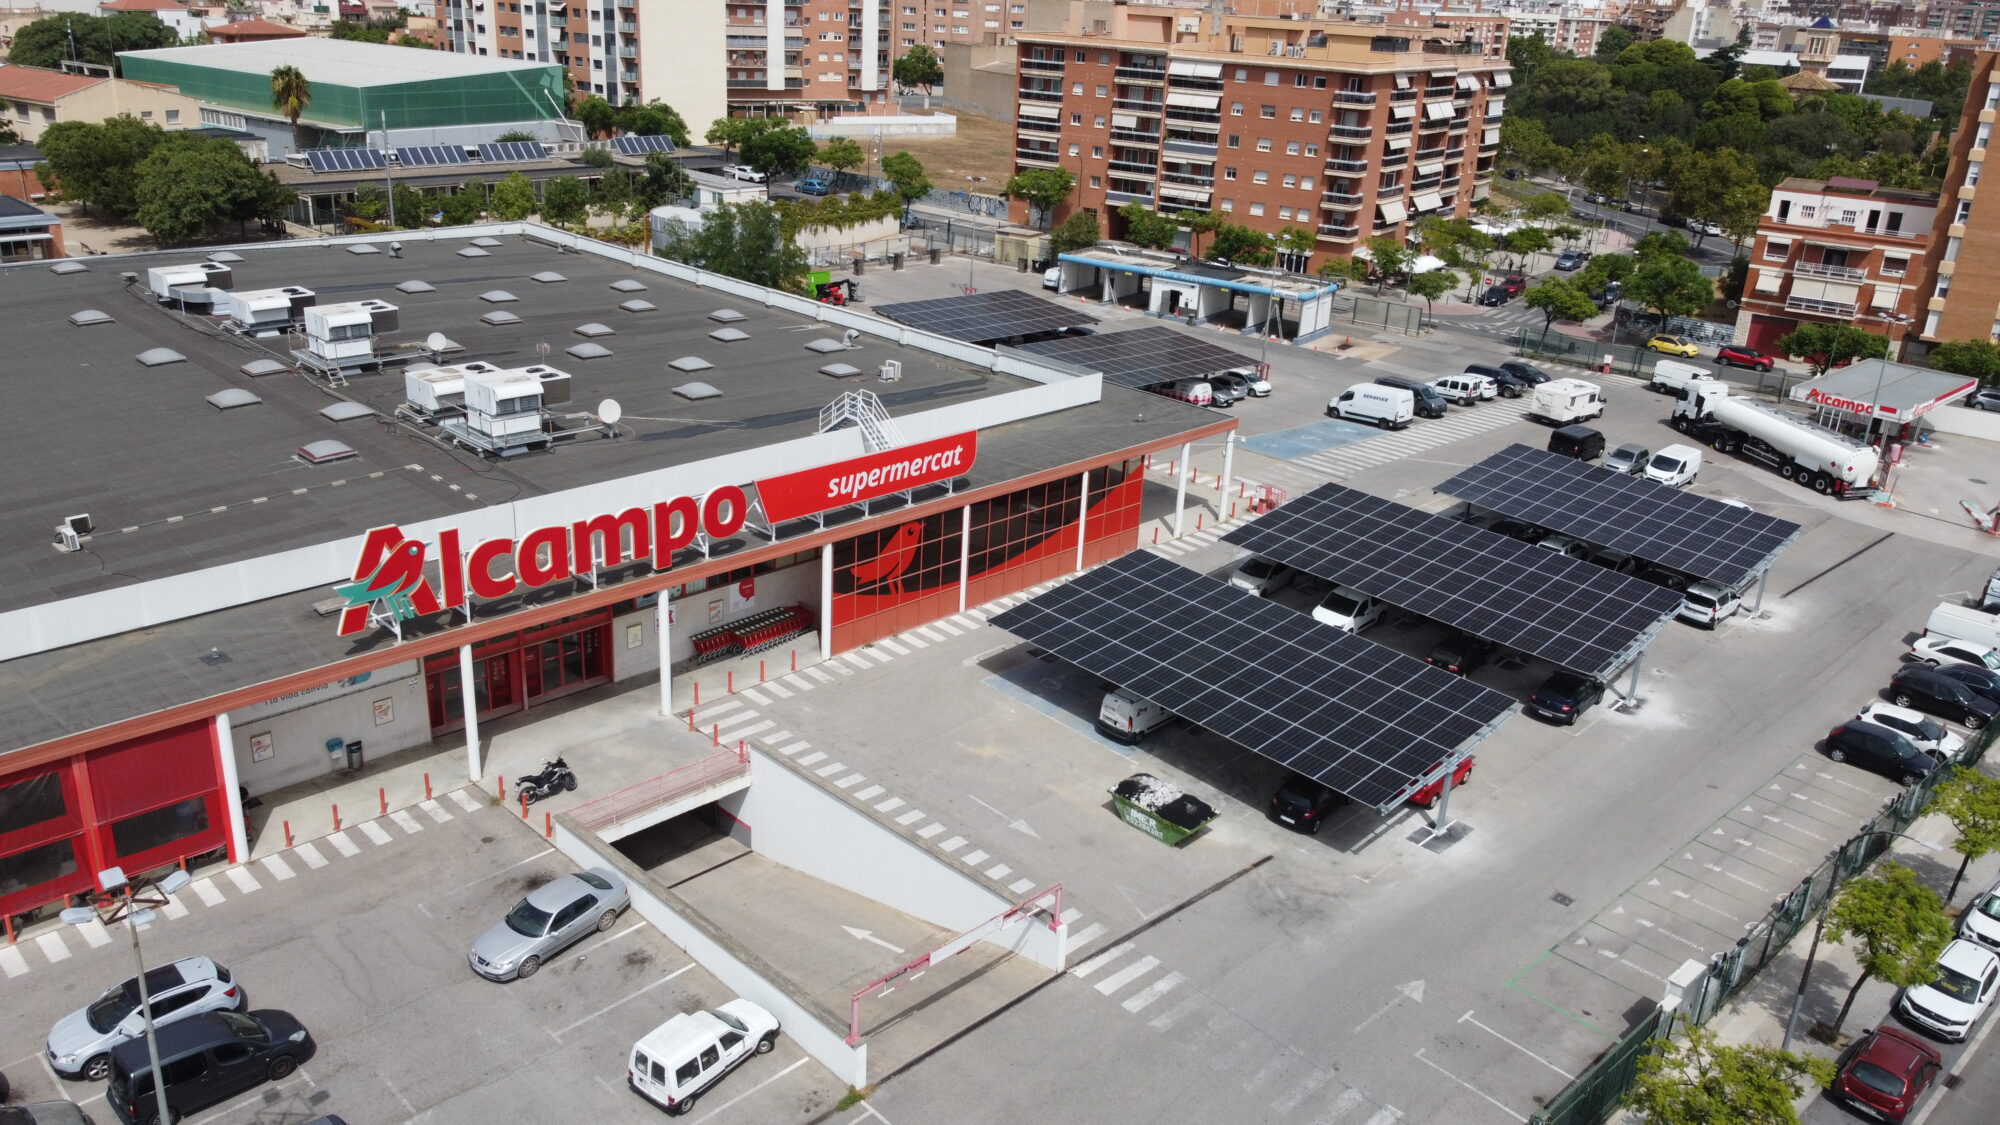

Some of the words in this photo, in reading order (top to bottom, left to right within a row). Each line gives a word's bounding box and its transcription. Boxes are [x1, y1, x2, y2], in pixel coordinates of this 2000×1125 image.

[1805, 388, 1874, 414] Alcampo
[827, 444, 963, 498] supermercat
[334, 484, 746, 635] Alcampo
[1130, 808, 1157, 829] IMER
